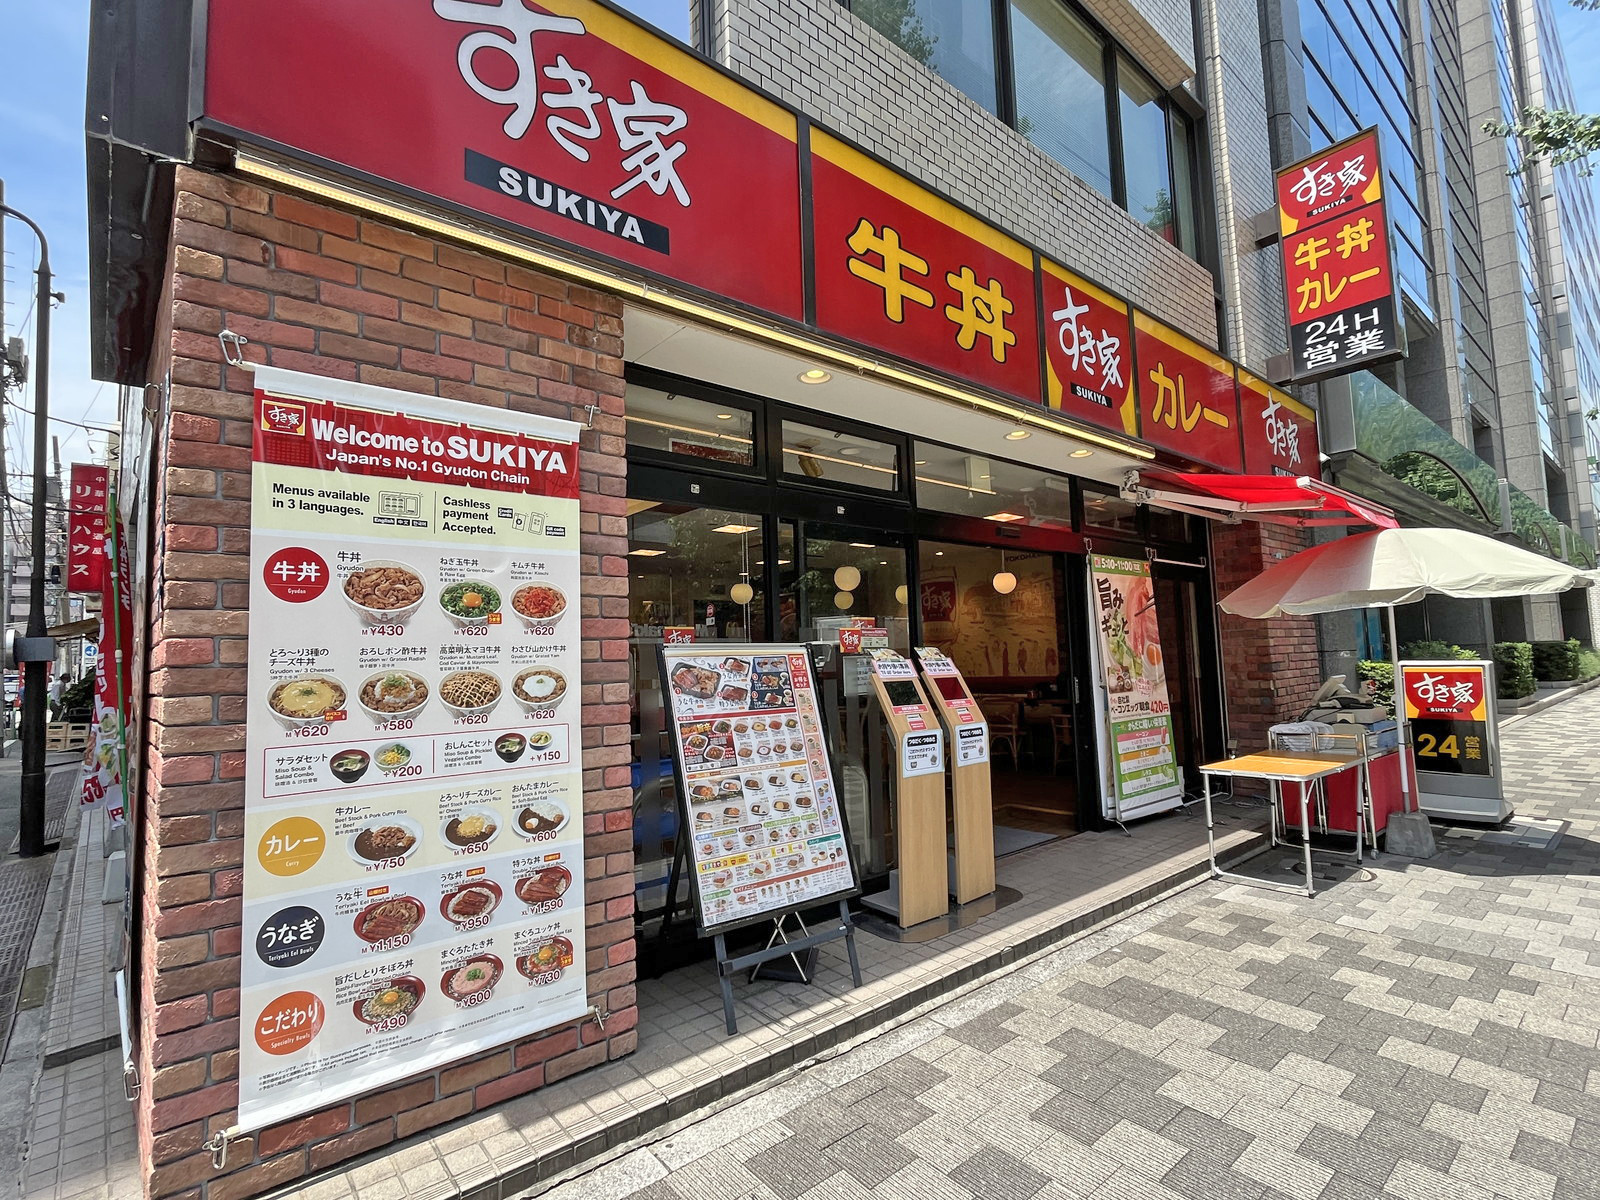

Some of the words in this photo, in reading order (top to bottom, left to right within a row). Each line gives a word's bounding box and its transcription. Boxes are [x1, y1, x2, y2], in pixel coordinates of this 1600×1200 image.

[433, 0, 692, 207] すき家
[1290, 154, 1367, 205] すき家
[498, 166, 645, 245] SUKIYA
[1312, 198, 1346, 215] SUKIYA
[1294, 217, 1376, 271] 牛丼
[846, 216, 1017, 364] 牛丼
[1296, 266, 1381, 314] カレー
[1052, 287, 1123, 391] すき家
[1303, 328, 1385, 369] 営業
[1076, 385, 1107, 406] SUKIYA
[1150, 362, 1229, 432] カレー
[268, 406, 300, 426] すき家
[1261, 390, 1301, 468] すき家
[312, 418, 419, 453] Welcome
[422, 436, 444, 457] to
[447, 436, 568, 474] SUKIYA
[325, 449, 391, 468] Japan's
[395, 456, 428, 472] No.1
[432, 460, 487, 480] Gyudon
[491, 471, 530, 485] Chain
[273, 483, 314, 496] Menus
[318, 489, 370, 502] available
[273, 498, 283, 507] in
[288, 499, 296, 508] 3
[300, 500, 364, 516] languages.
[443, 496, 490, 509] Cashless
[443, 510, 488, 520] payment
[443, 522, 496, 534] Accepted.
[337, 551, 361, 562] 牛丼
[440, 558, 479, 566] ねぎ玉牛丼
[273, 561, 320, 582] 牛丼
[1097, 578, 1124, 611] 旨み
[370, 626, 403, 636] ¥430
[461, 627, 487, 635] ¥620
[530, 627, 554, 635] ¥620
[360, 647, 427, 655] おろしポン酢牛丼
[440, 646, 501, 654] 高菜明太マヨ牛丼
[512, 645, 566, 653] わさび山かけ牛丼
[269, 658, 316, 666] チーズ牛丼
[1413, 673, 1475, 707] すき家
[461, 715, 488, 725] ¥620
[531, 710, 554, 719] ¥620
[294, 726, 329, 737] ¥620
[383, 720, 413, 730] ¥580
[445, 739, 492, 750] おしんこセット
[1418, 734, 1460, 758] 24
[276, 754, 328, 766] サラダセット
[512, 781, 559, 792] おんたまカレー
[335, 806, 371, 816] 牛カレー
[532, 830, 557, 842] ¥600
[266, 836, 318, 856] カレー
[461, 842, 489, 855] ¥650
[374, 857, 405, 871] ¥750
[512, 856, 540, 867] 特うな丼
[441, 871, 462, 882] うな丼
[336, 890, 363, 902] うな牛
[335, 902, 359, 910] Teriyaki
[530, 899, 563, 914] ¥1,590
[462, 916, 489, 930] ¥950
[514, 922, 560, 939] まぐろユッケ丼
[262, 916, 319, 948] うなぎ
[369, 935, 410, 953] ¥1,150
[441, 938, 494, 958] まぐろたたき丼
[269, 952, 289, 961] Teriyaki
[300, 947, 314, 955] Bowls
[335, 960, 414, 986] 旨だしとりそぼろ丼
[534, 971, 560, 986] ¥730
[336, 979, 373, 992] Dashi-Flavored
[348, 988, 361, 996] Bowl
[464, 990, 491, 1006] ¥600
[261, 1002, 318, 1035] こだわり
[374, 1015, 407, 1033] ¥490
[271, 1037, 294, 1049] Specialty
[296, 1033, 311, 1041] Bowls
